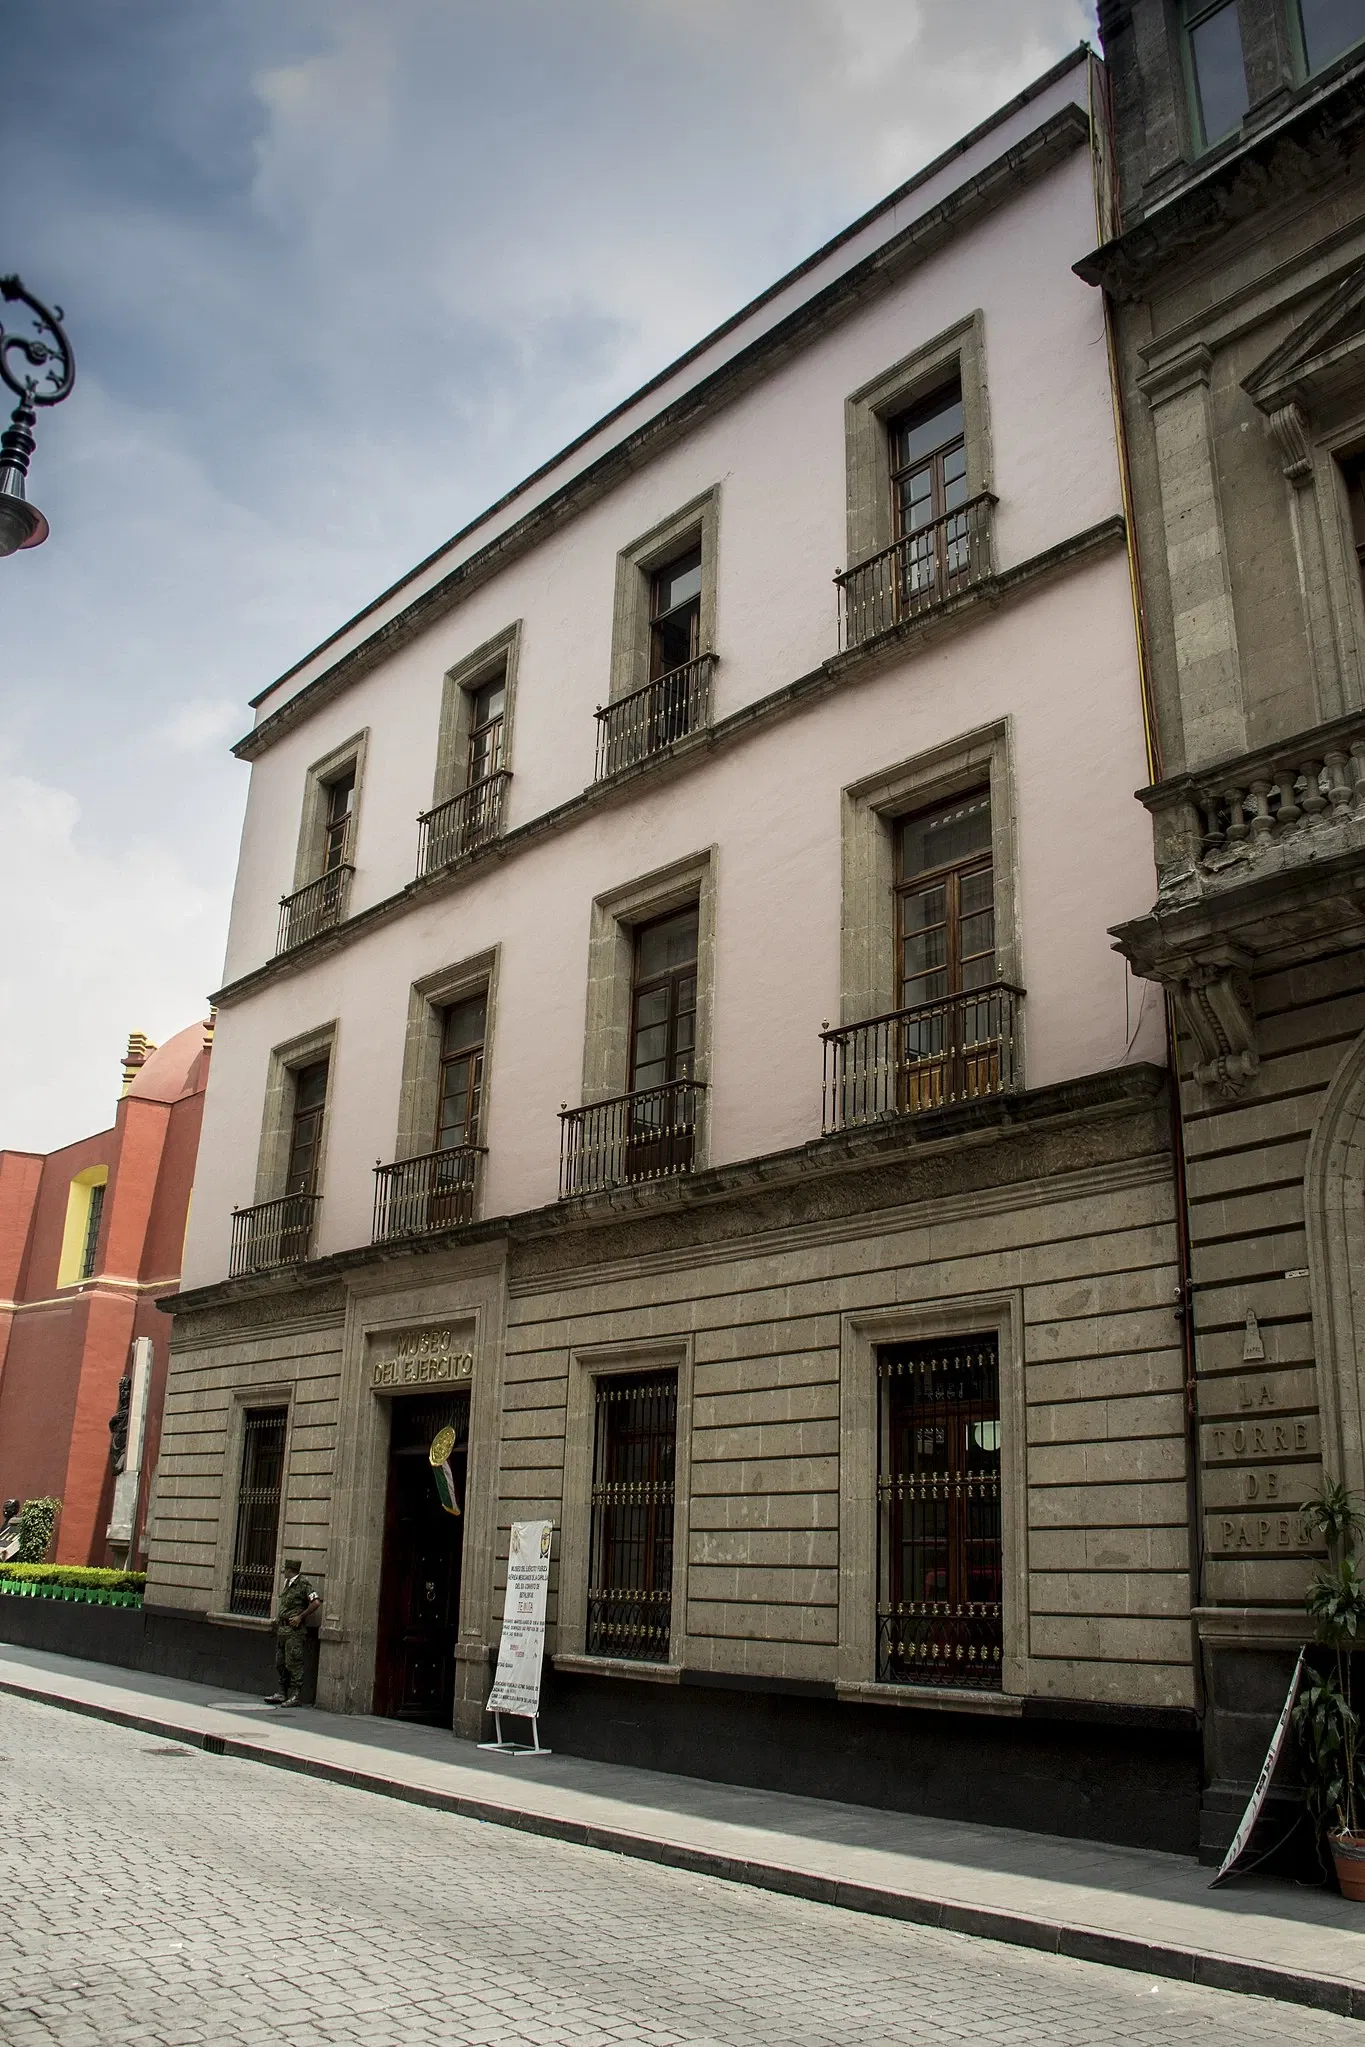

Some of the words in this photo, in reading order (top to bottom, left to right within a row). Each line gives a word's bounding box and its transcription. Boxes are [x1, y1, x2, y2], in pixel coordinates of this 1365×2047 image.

[397, 1329, 452, 1357] MUSEO
[373, 1361, 400, 1385] DEL
[404, 1353, 474, 1382] EJERCITO
[1239, 1382, 1275, 1407] LA
[1213, 1423, 1308, 1455] TORRE
[1247, 1473, 1278, 1499] DE
[1221, 1517, 1310, 1547] PAPEL
